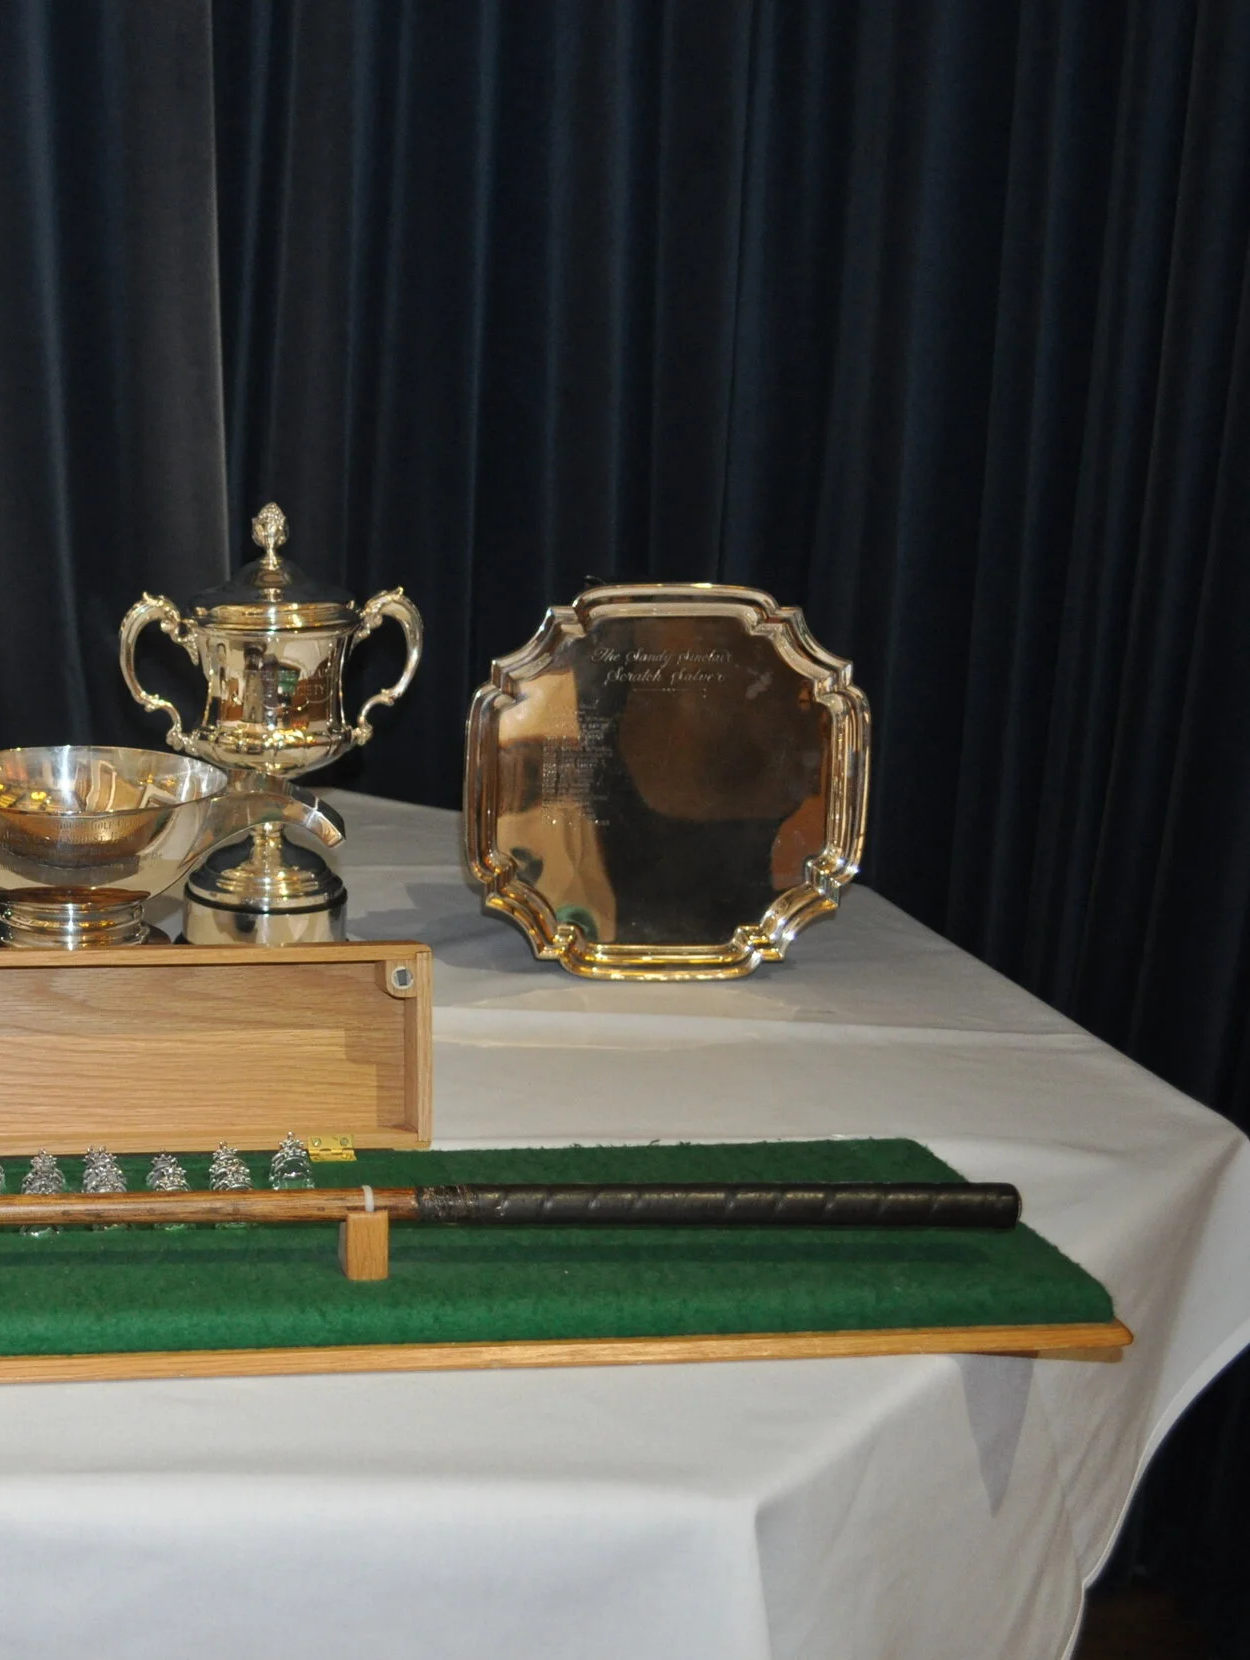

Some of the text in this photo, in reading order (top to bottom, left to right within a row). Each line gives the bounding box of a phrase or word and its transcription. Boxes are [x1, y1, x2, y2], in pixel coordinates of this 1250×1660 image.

[592, 648, 733, 668] The Sandy Sinclair
[604, 667, 725, 686] Scratch Salver
